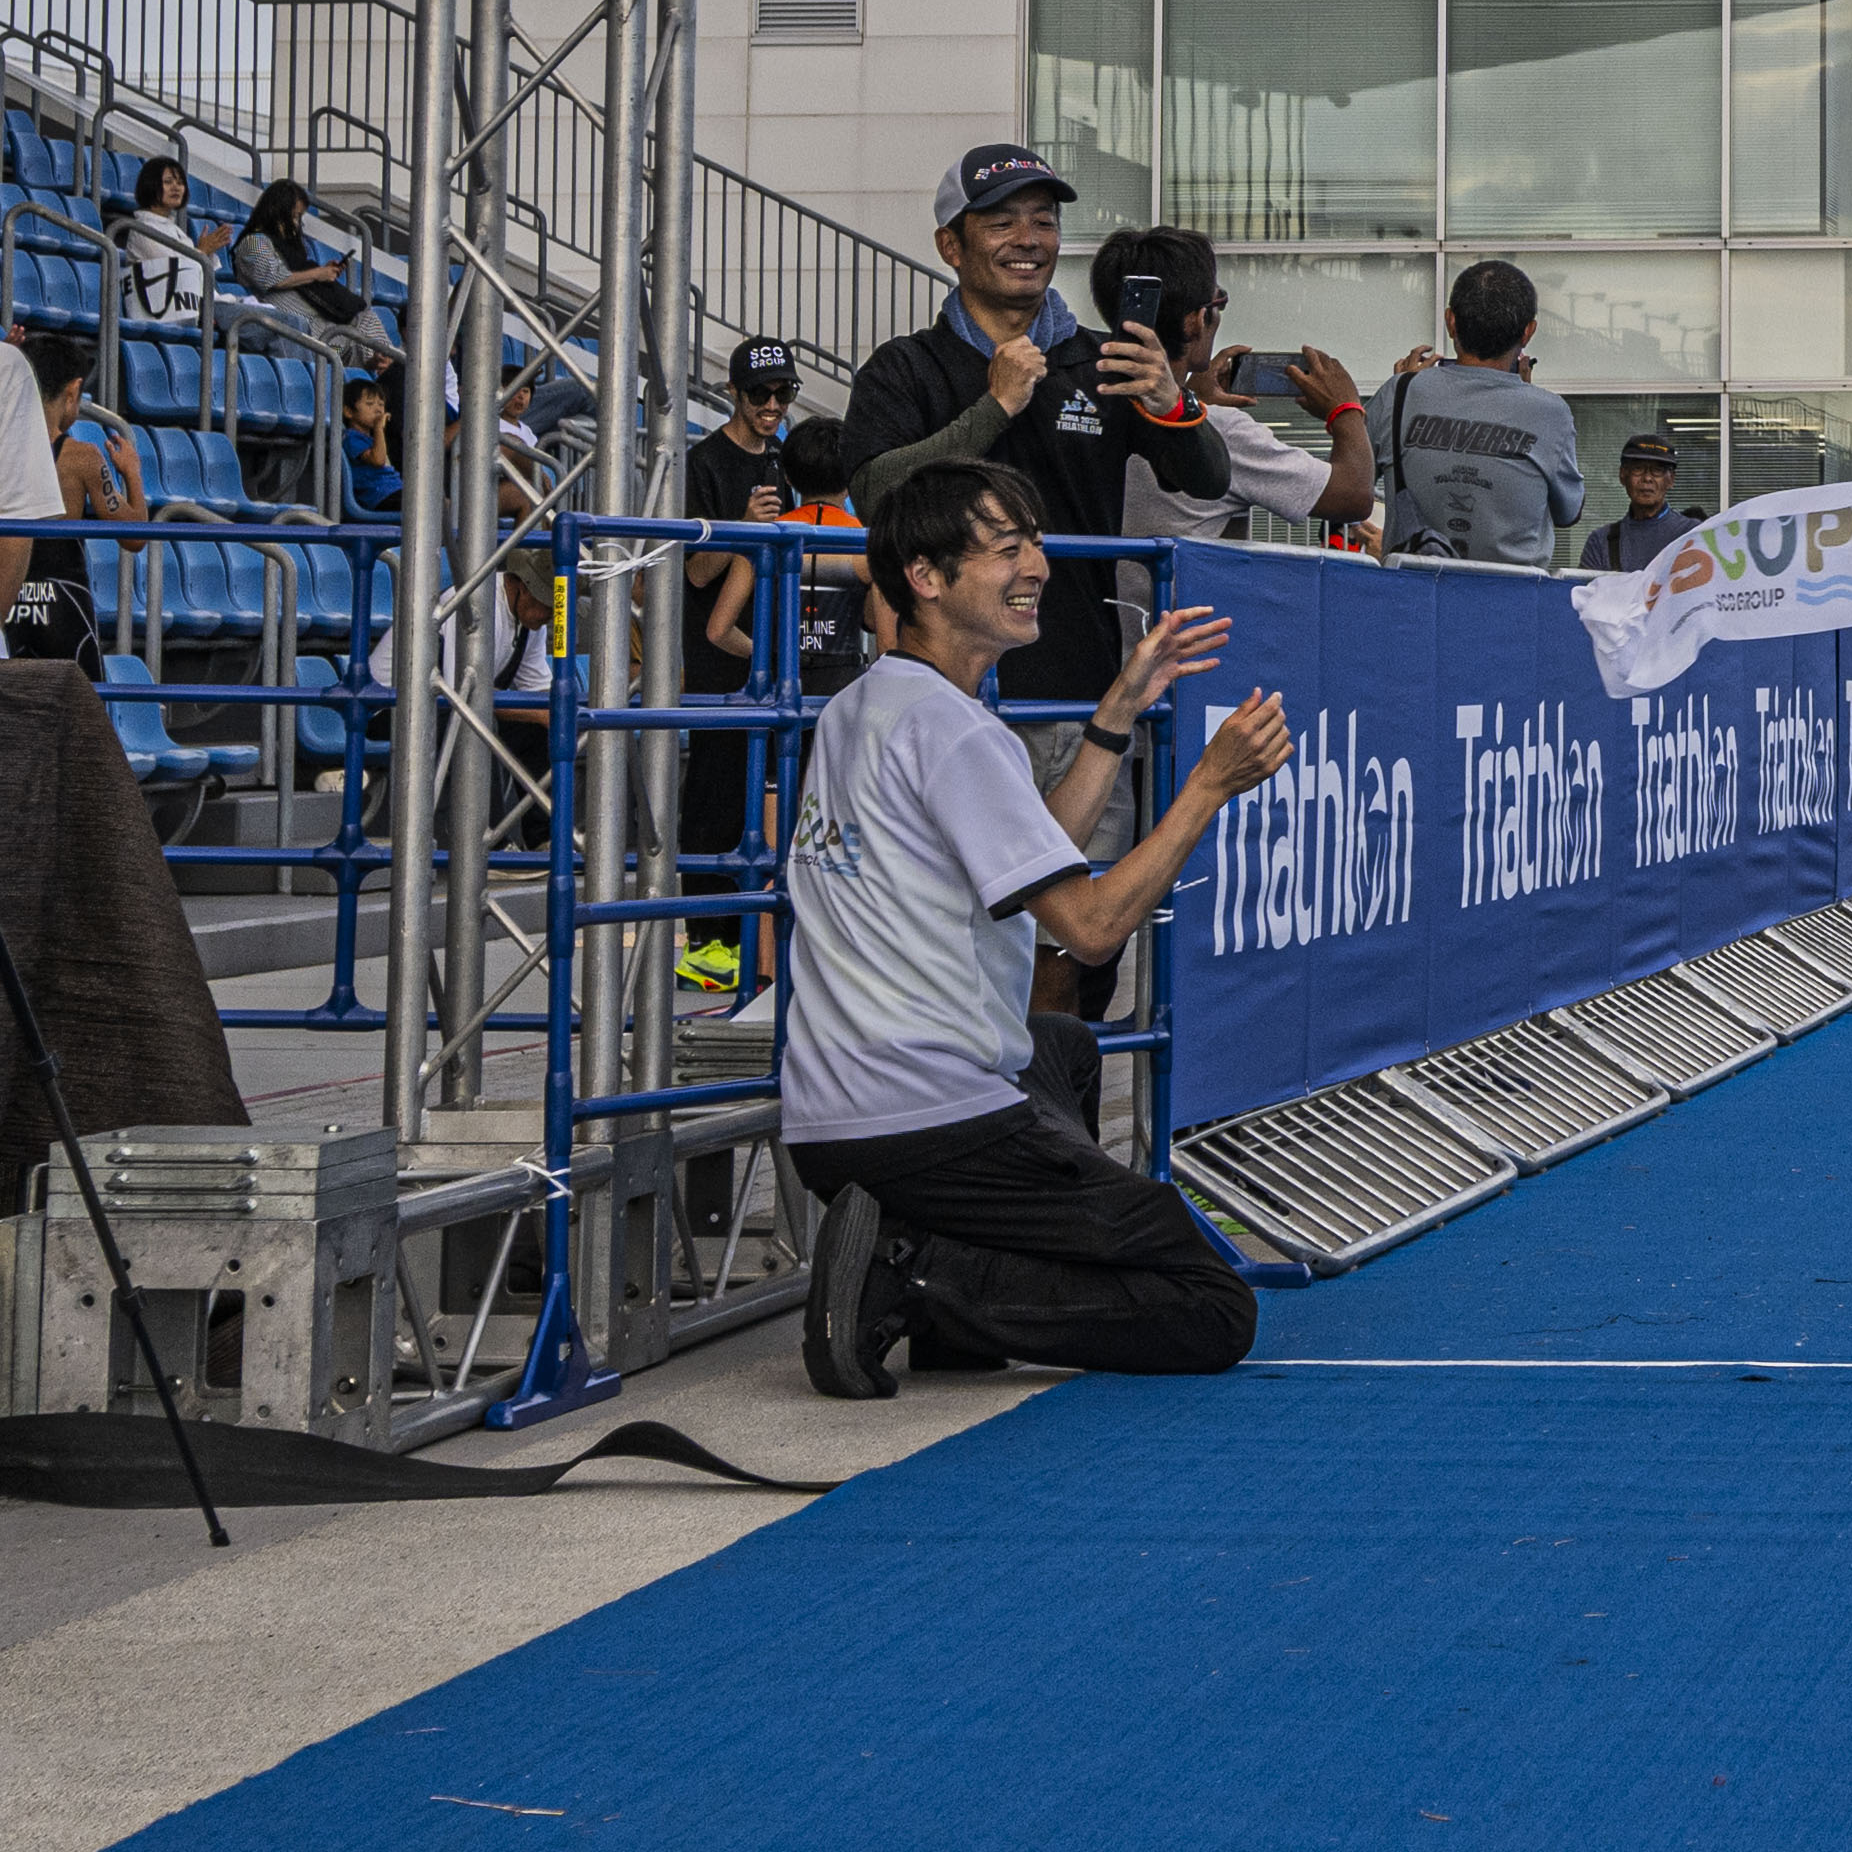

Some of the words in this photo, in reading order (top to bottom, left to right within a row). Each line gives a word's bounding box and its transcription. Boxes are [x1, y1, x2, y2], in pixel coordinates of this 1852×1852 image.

[749, 346, 784, 360] SCO
[1403, 413, 1539, 461] CONVERSE
[799, 635, 822, 651] JPN
[1456, 700, 1604, 909] Triathlon
[1630, 693, 1738, 869] Triathlon
[1755, 685, 1835, 836] Triathlon
